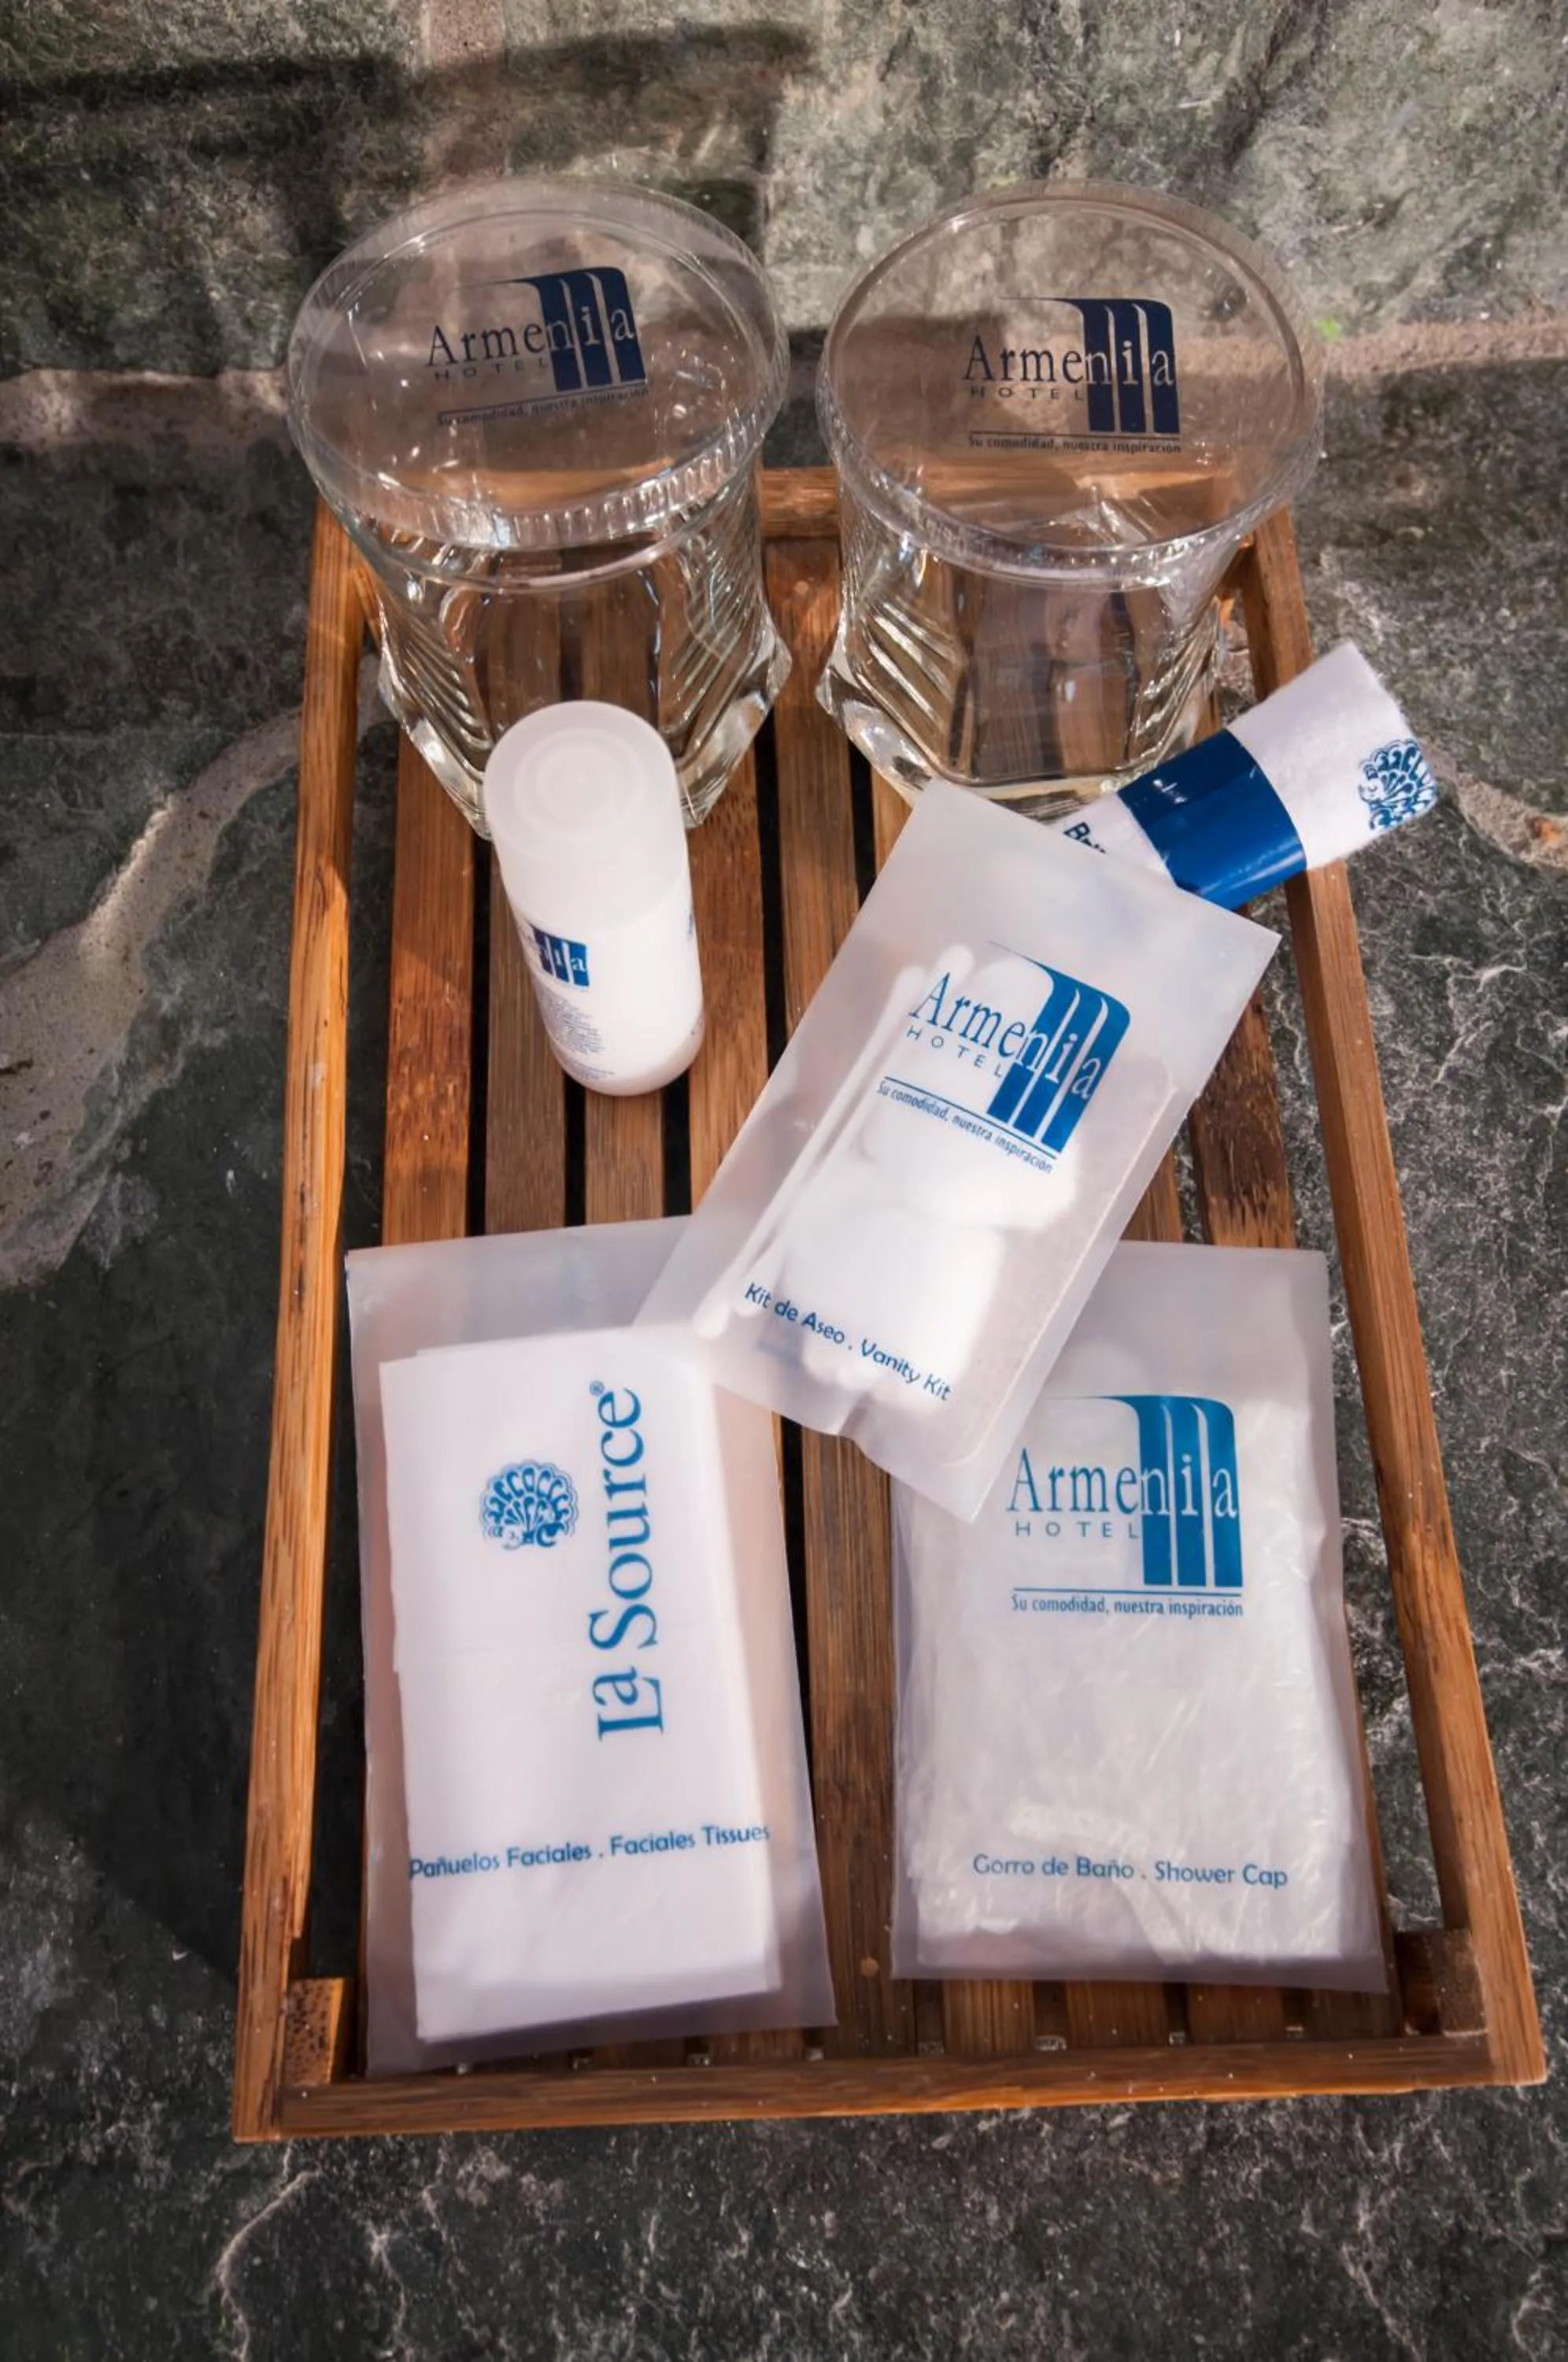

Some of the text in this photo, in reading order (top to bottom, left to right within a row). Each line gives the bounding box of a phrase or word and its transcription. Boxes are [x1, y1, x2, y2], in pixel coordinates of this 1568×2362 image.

[425, 305, 635, 368] Armenia
[962, 335, 1175, 386] Armenia
[434, 358, 550, 382] HOTEL
[970, 387, 1085, 401] HOTEL
[906, 1025, 1004, 1079] HOTEL
[908, 972, 1101, 1100] Armenia
[876, 1079, 891, 1096] Su
[952, 1114, 993, 1142] nuestra
[744, 1282, 772, 1309] Kit
[774, 1300, 799, 1322] de
[801, 1311, 845, 1345] Aseo
[860, 1338, 921, 1384] Vanity
[923, 1373, 952, 1401] Kit
[1005, 1448, 1238, 1520] Armenia
[1015, 1521, 1141, 1539] HOTEL
[1011, 1594, 1028, 1612] Su
[1114, 1598, 1165, 1615] nuestra
[1169, 1598, 1244, 1620] inspiración
[408, 1851, 501, 1879] Pañuelos
[506, 1842, 592, 1868] Faciales
[609, 1829, 696, 1857] Faciales
[701, 1823, 771, 1846] Tissues
[972, 1853, 1035, 1876] Gorro
[1041, 1855, 1070, 1876] de
[1075, 1857, 1134, 1881] Baño
[1153, 1860, 1236, 1884] Shower
[1242, 1864, 1289, 1890] Cap
